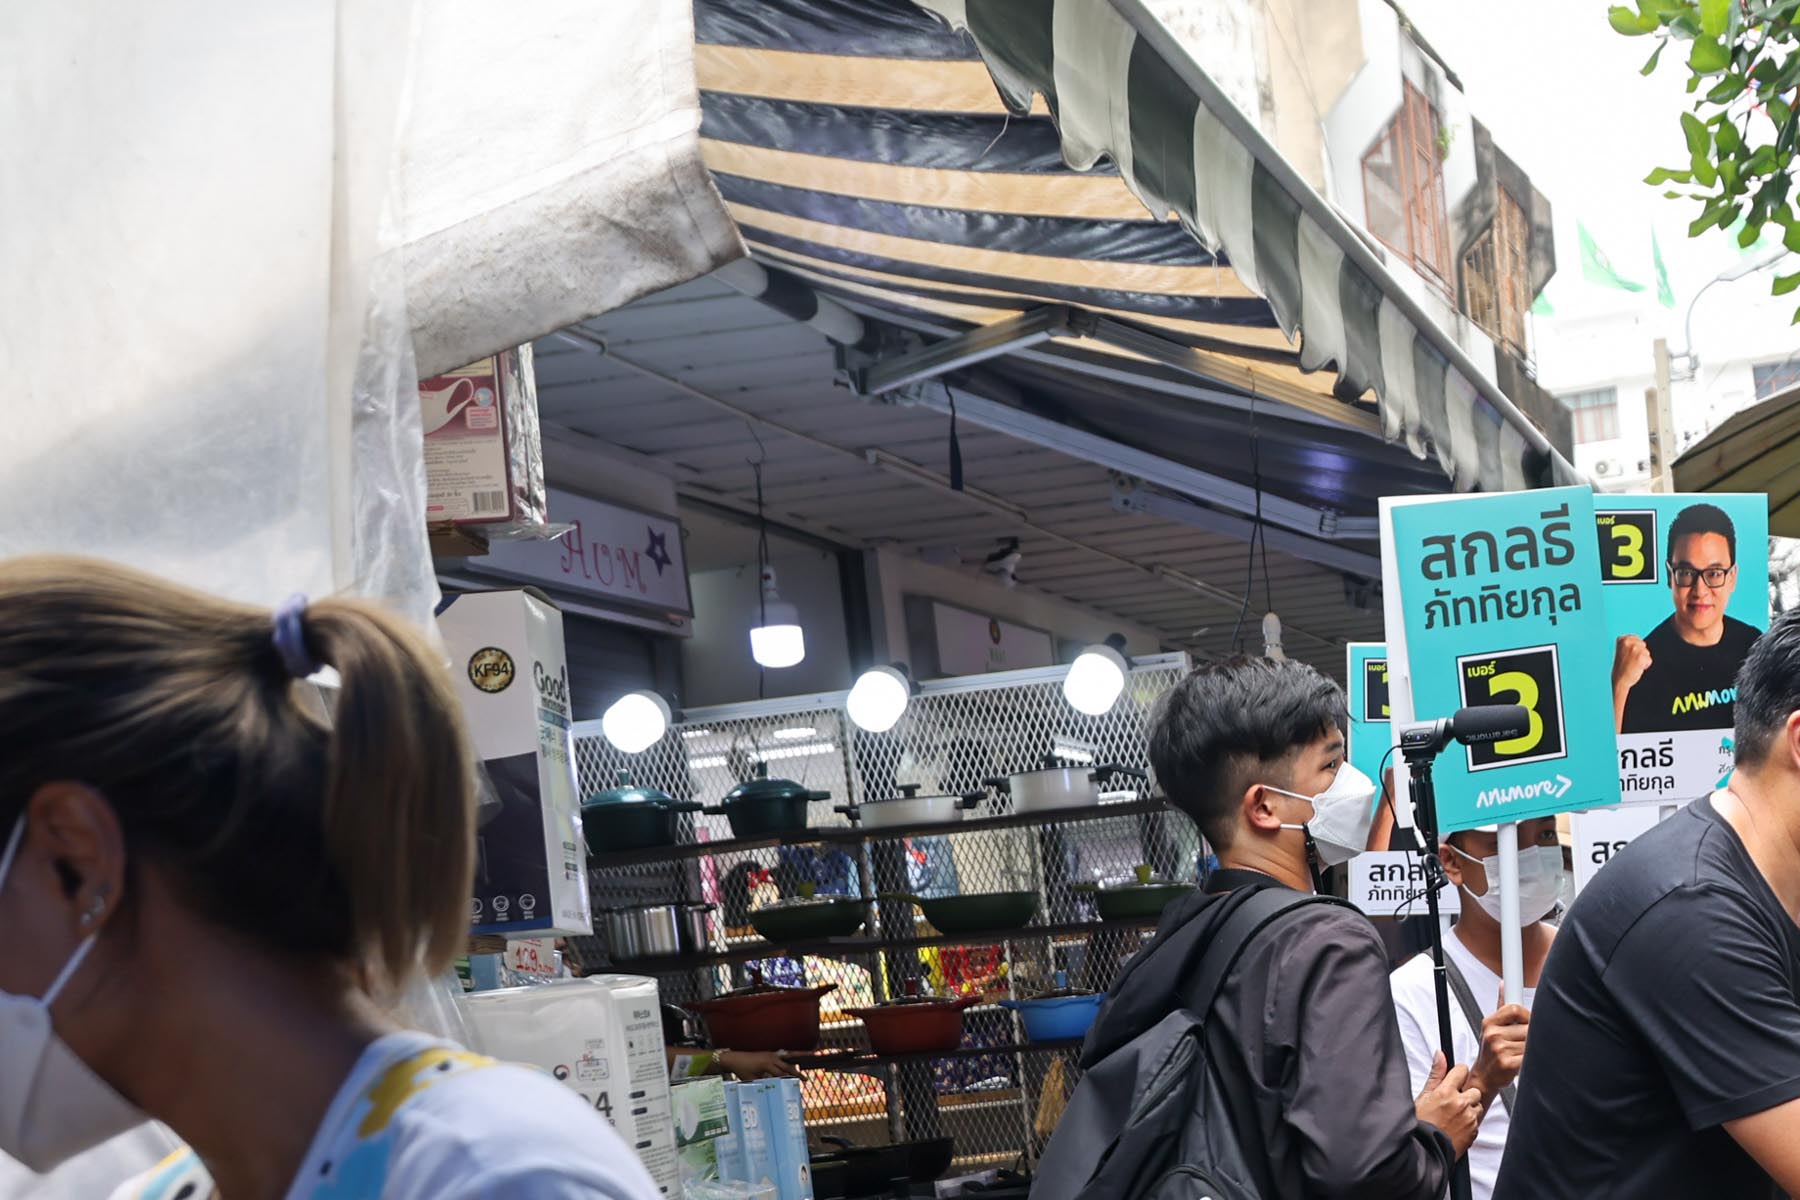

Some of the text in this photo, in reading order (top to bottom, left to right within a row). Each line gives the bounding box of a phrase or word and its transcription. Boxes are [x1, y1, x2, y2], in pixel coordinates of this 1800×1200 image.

[1421, 502, 1576, 581] สกลธี
[1611, 523, 1645, 578] 3
[1424, 583, 1582, 630] ภัททิยกุล
[474, 661, 509, 679] KF94
[1467, 660, 1497, 678] เบอร์
[1488, 671, 1544, 755] 3
[1617, 737, 1674, 769] กลธี
[1369, 863, 1425, 882] สกล
